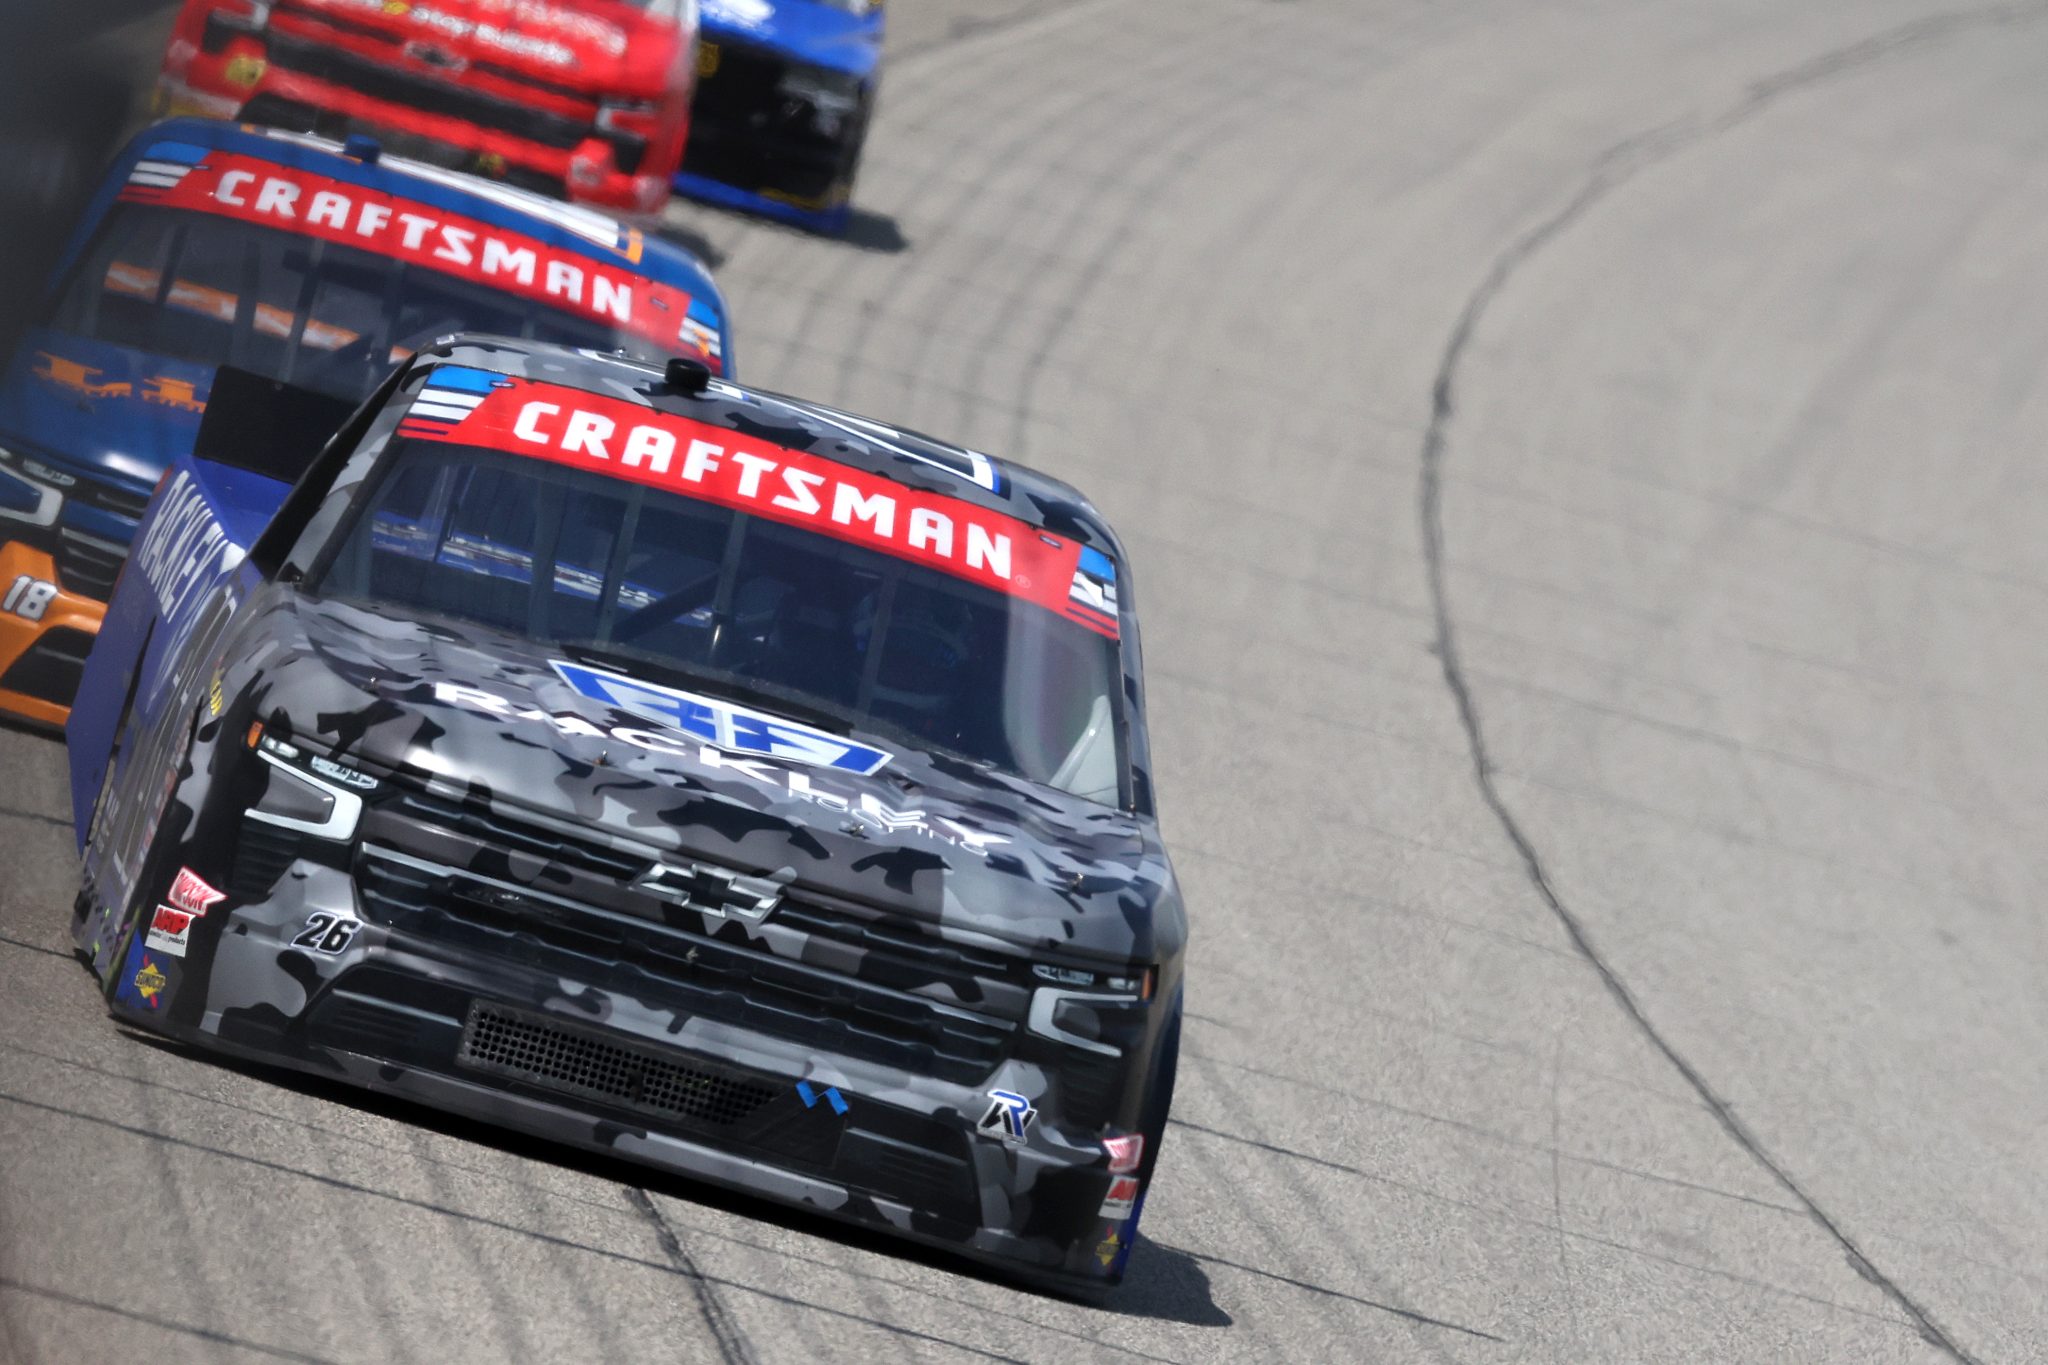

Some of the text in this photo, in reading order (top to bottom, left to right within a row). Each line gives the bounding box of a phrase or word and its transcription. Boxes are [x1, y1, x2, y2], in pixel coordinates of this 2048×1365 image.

[216, 170, 632, 323] CRAFTSMAN
[513, 401, 1011, 580] CRAFTSMAN
[3, 575, 58, 621] 18
[290, 911, 362, 955] 26
